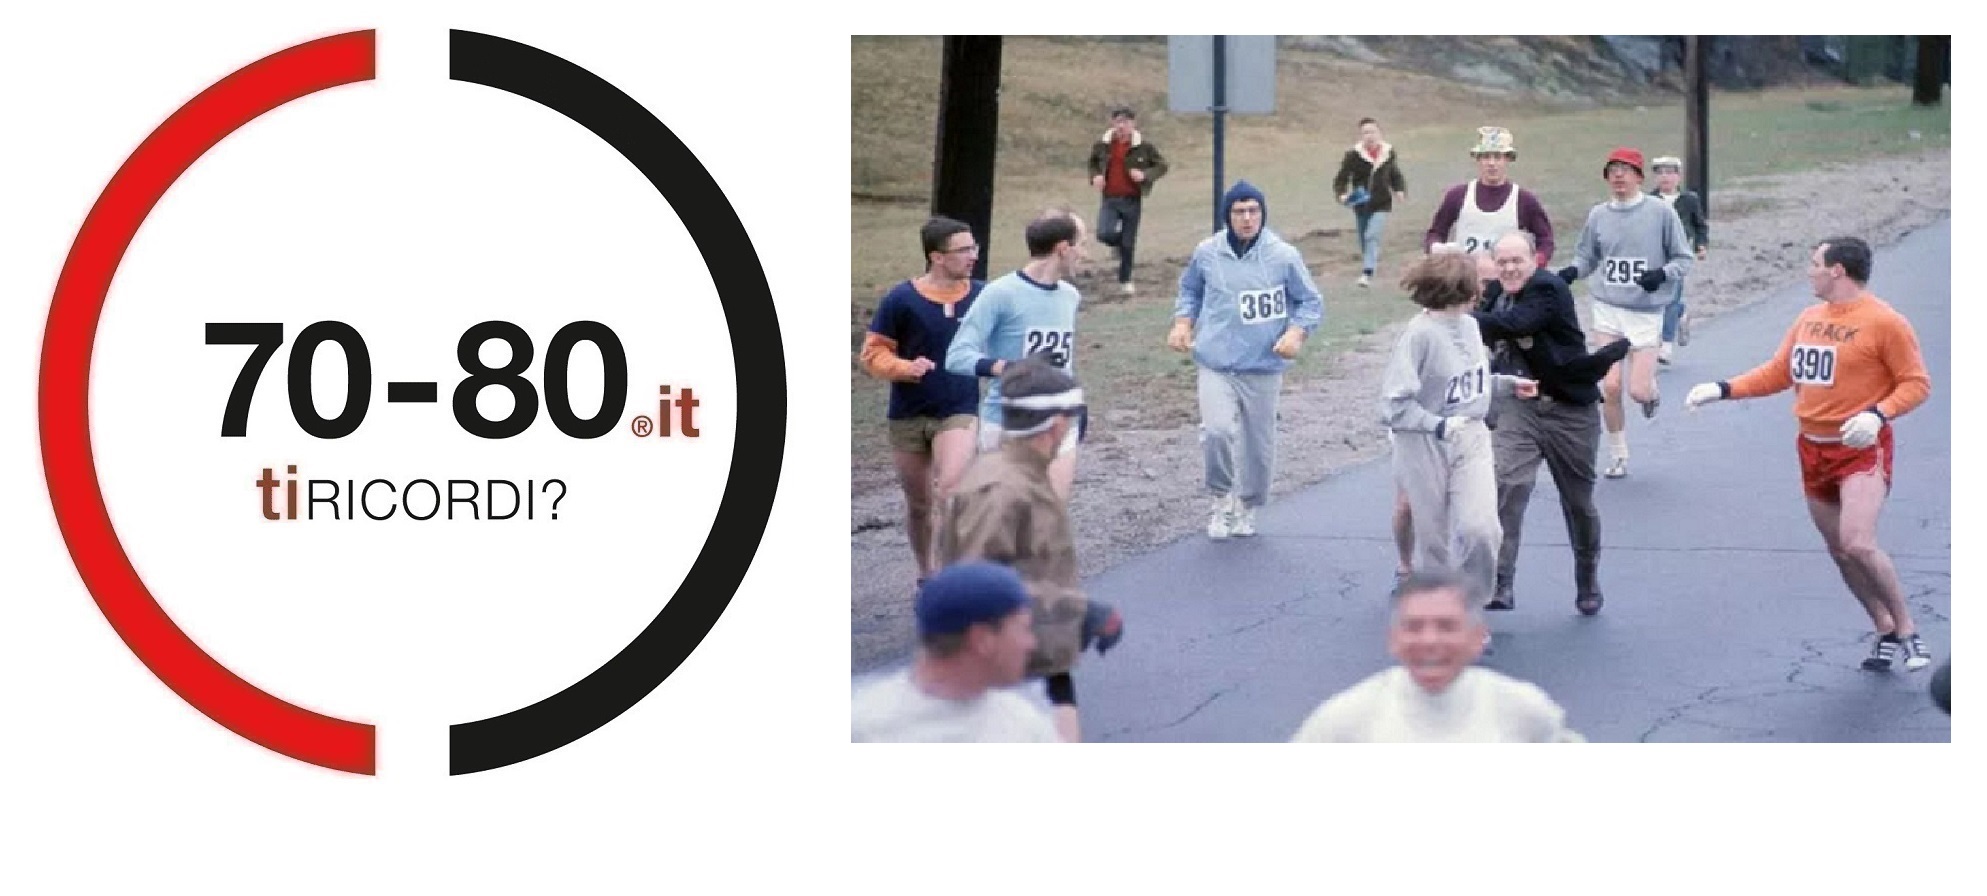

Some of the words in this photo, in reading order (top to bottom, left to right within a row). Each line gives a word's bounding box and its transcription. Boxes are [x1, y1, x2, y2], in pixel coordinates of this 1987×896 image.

[1606, 259, 1646, 284] 295
[1241, 289, 1284, 320] 368
[1027, 330, 1072, 364] 225
[1805, 321, 1859, 343] TRACK
[1792, 347, 1834, 381] 390
[1446, 365, 1484, 404] 261
